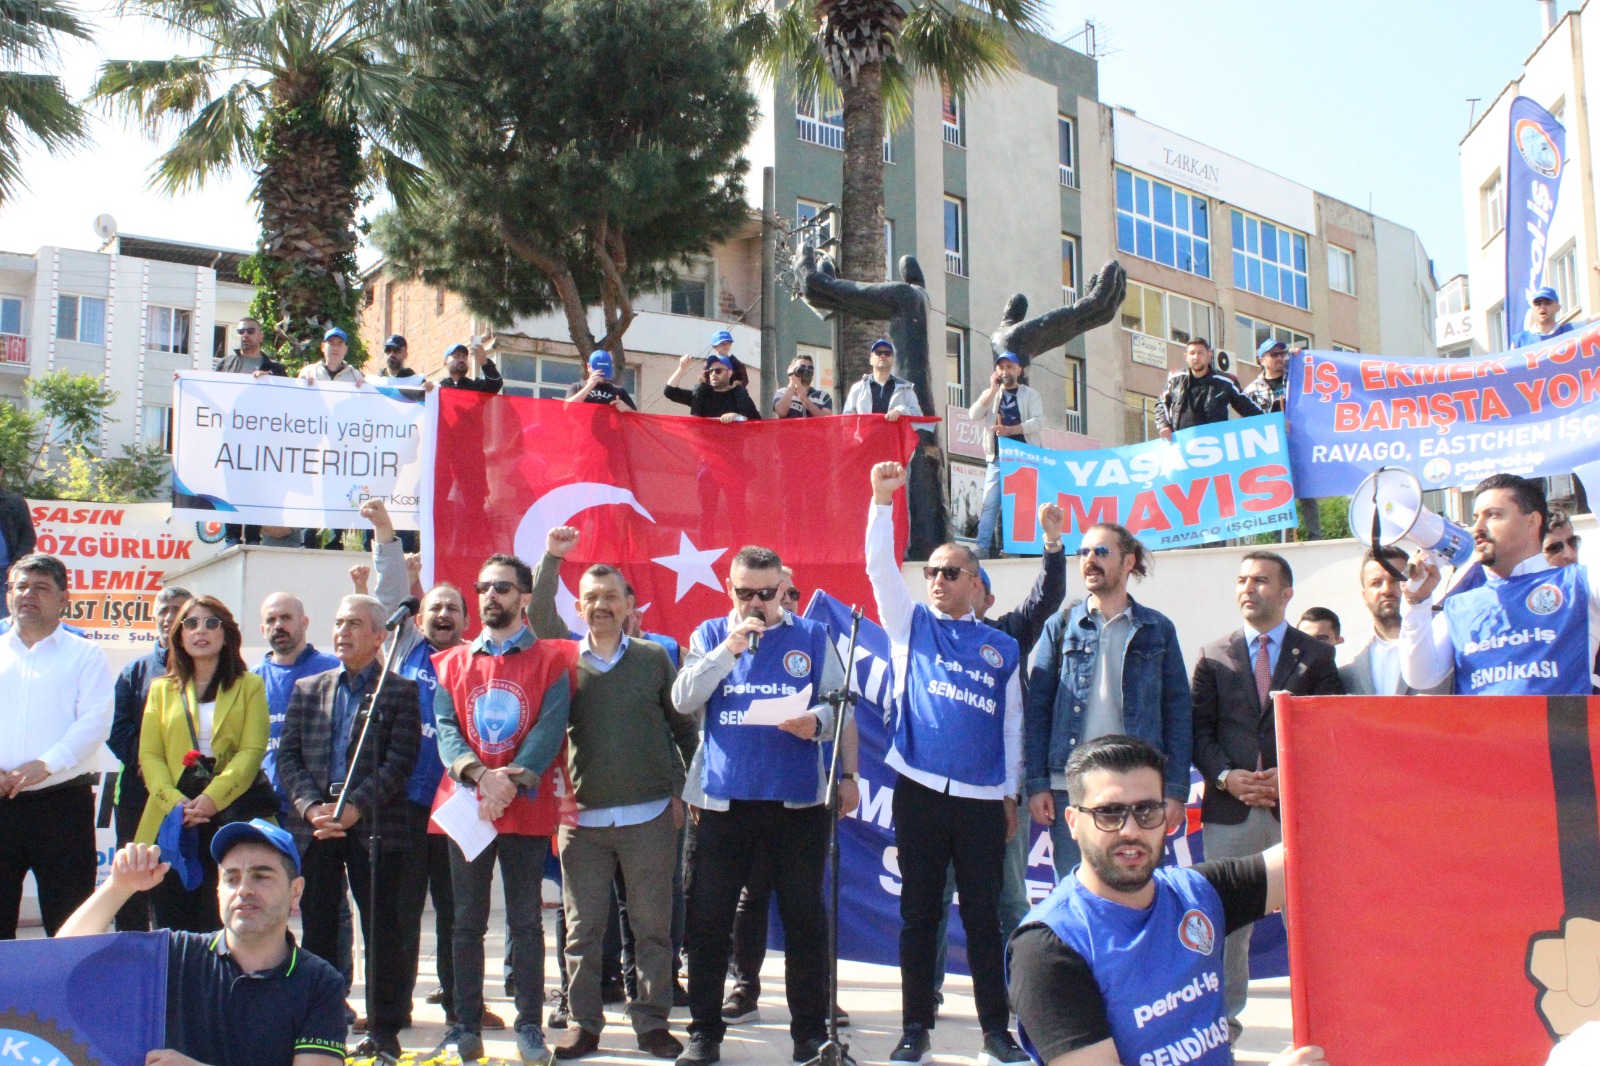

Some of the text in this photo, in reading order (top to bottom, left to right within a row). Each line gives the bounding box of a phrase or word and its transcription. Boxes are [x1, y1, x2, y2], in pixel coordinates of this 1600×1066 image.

[1163, 147, 1220, 182] TARKAN
[1525, 180, 1553, 306] trol-iş
[1302, 355, 1351, 402] İŞ,
[1359, 354, 1512, 391] EKMEK
[196, 406, 418, 442] En bereketli yağmur
[1333, 386, 1511, 434] BARIŞTA
[1312, 413, 1600, 463] RAVAGO, EASTCHEM İŞÇ
[214, 442, 399, 478] ALINTERİDİR
[1065, 424, 1281, 490] YAŞASIN
[31, 506, 125, 528] ŞASIN
[1003, 464, 1295, 543] 1 MAYIS
[36, 528, 193, 560] ÖZGÜRLÜK
[1161, 509, 1293, 545] RAVAGO İŞÇİLERİ
[66, 565, 165, 591] ELEMİZ
[60, 594, 156, 627] AST İŞÇİL
[86, 630, 120, 641] ebze
[1464, 627, 1556, 656] petrol-iş
[1470, 660, 1558, 689] SENDİKASI
[927, 679, 997, 715] SENDİKASI
[1133, 971, 1219, 1029] petrol-iş
